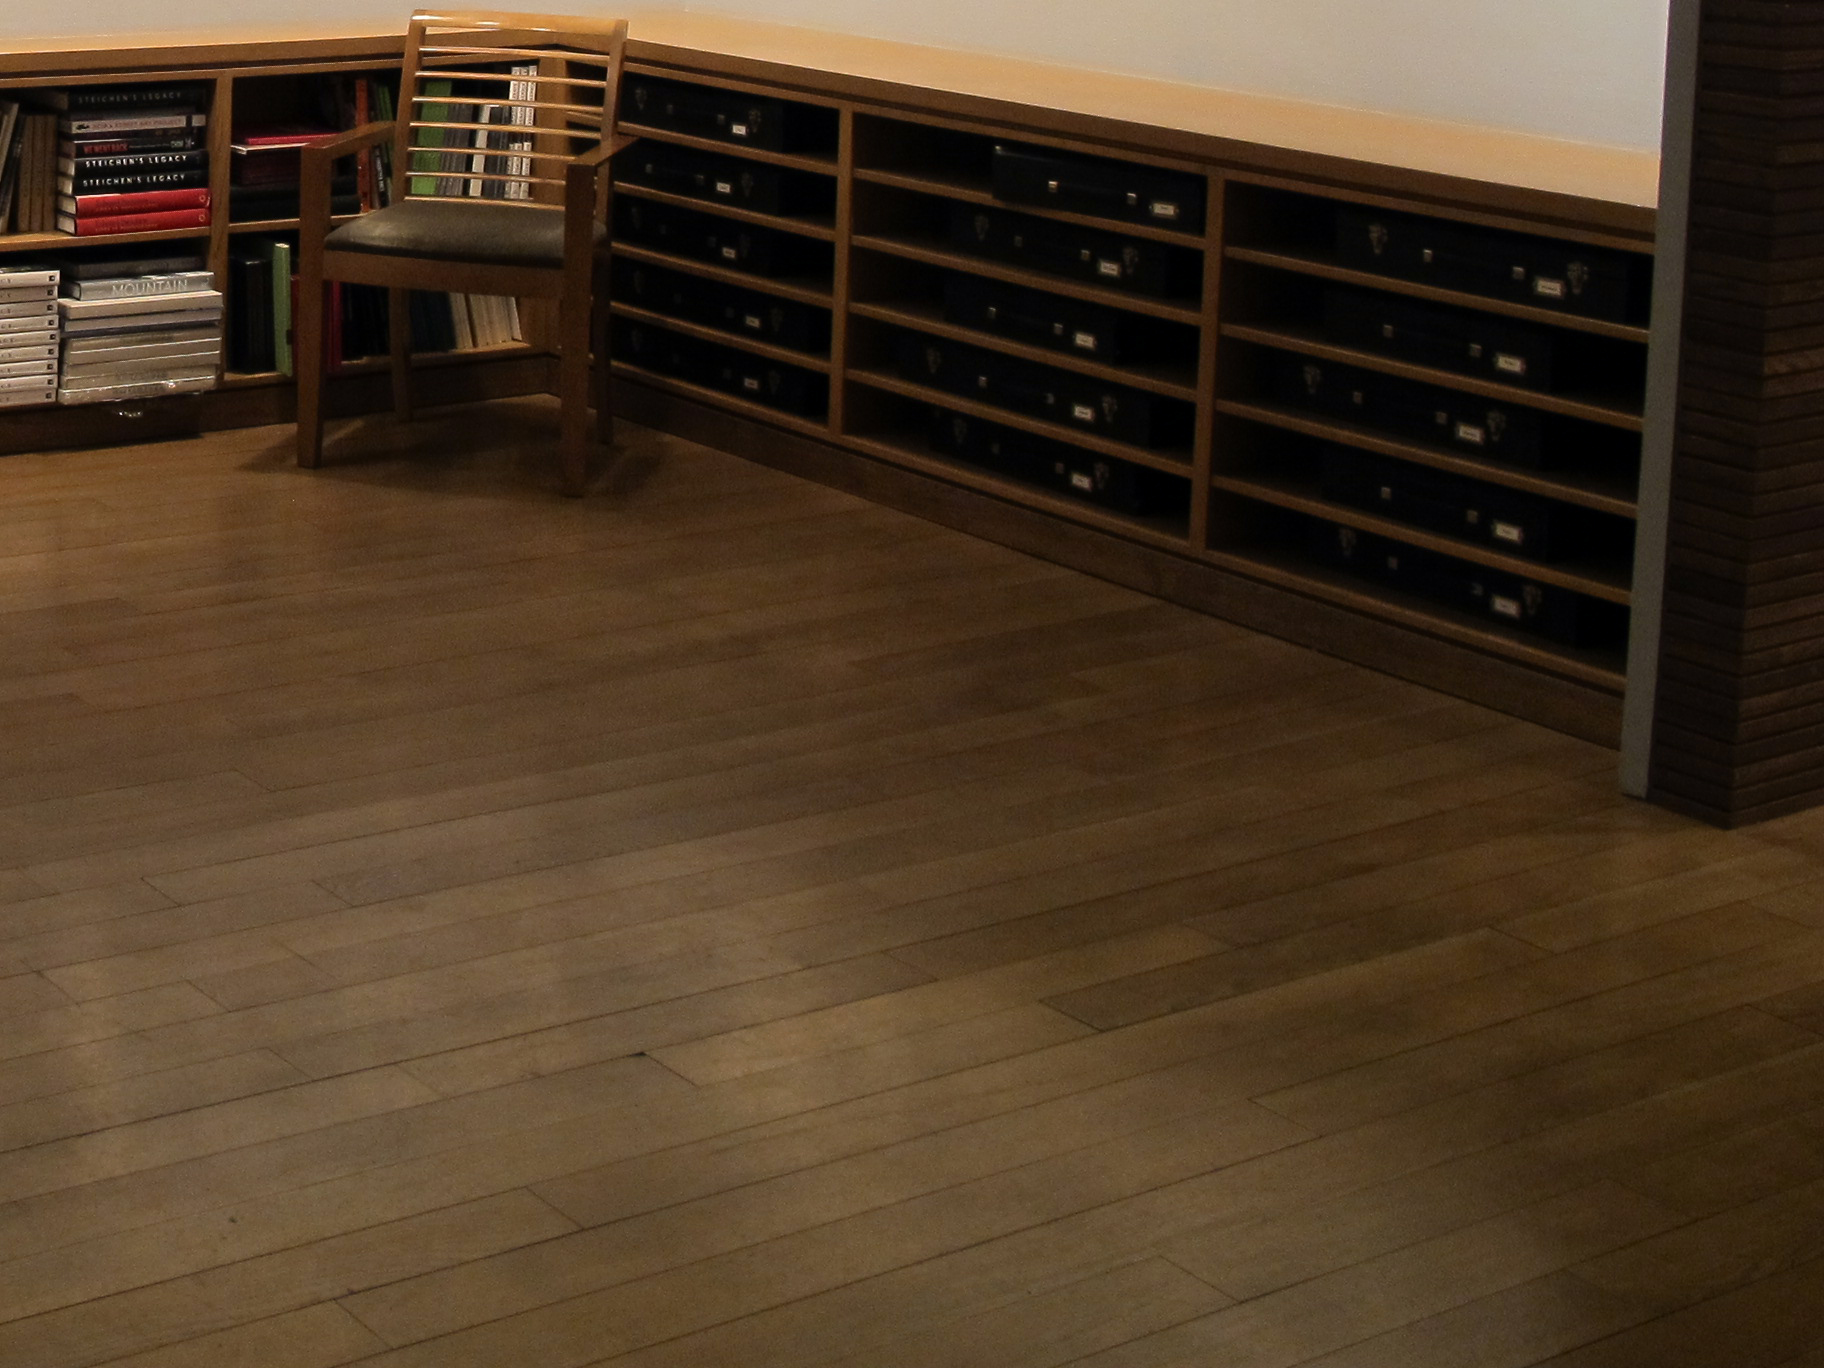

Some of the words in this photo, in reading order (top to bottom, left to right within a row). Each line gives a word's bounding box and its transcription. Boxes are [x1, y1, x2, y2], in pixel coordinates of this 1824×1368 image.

[143, 91, 182, 100] LEGACY
[85, 157, 144, 168] STEICHEN'S
[148, 155, 188, 164] LEGACY
[83, 176, 142, 187] STEICHEN'S
[147, 174, 186, 183] LEGACY
[112, 280, 188, 296] MOUNTAIN
